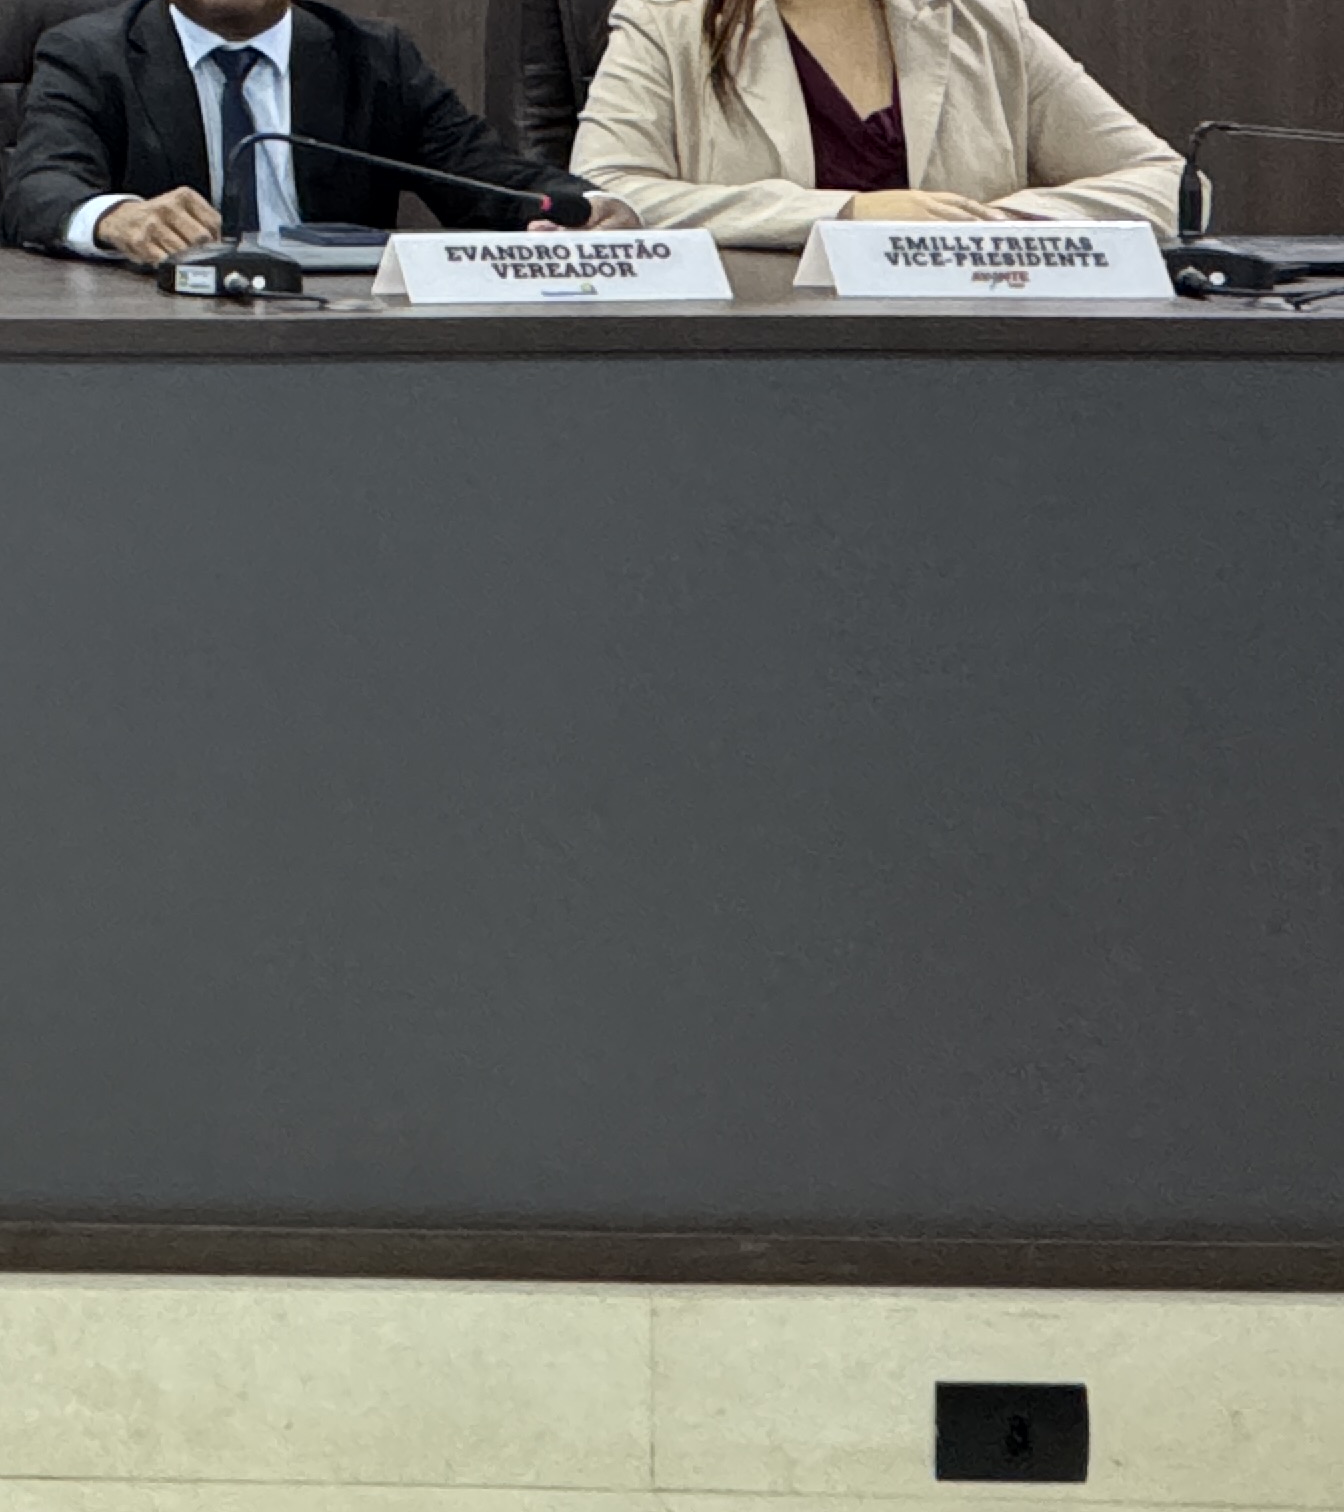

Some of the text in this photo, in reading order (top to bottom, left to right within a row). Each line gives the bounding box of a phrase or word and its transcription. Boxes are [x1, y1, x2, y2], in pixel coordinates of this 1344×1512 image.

[445, 238, 672, 262] EVANDRO LEITÃO
[888, 236, 1094, 252] EMILLY FREITAS
[884, 251, 1110, 268] VICE-PRESIDENTE
[491, 262, 638, 279] VEREADOR
